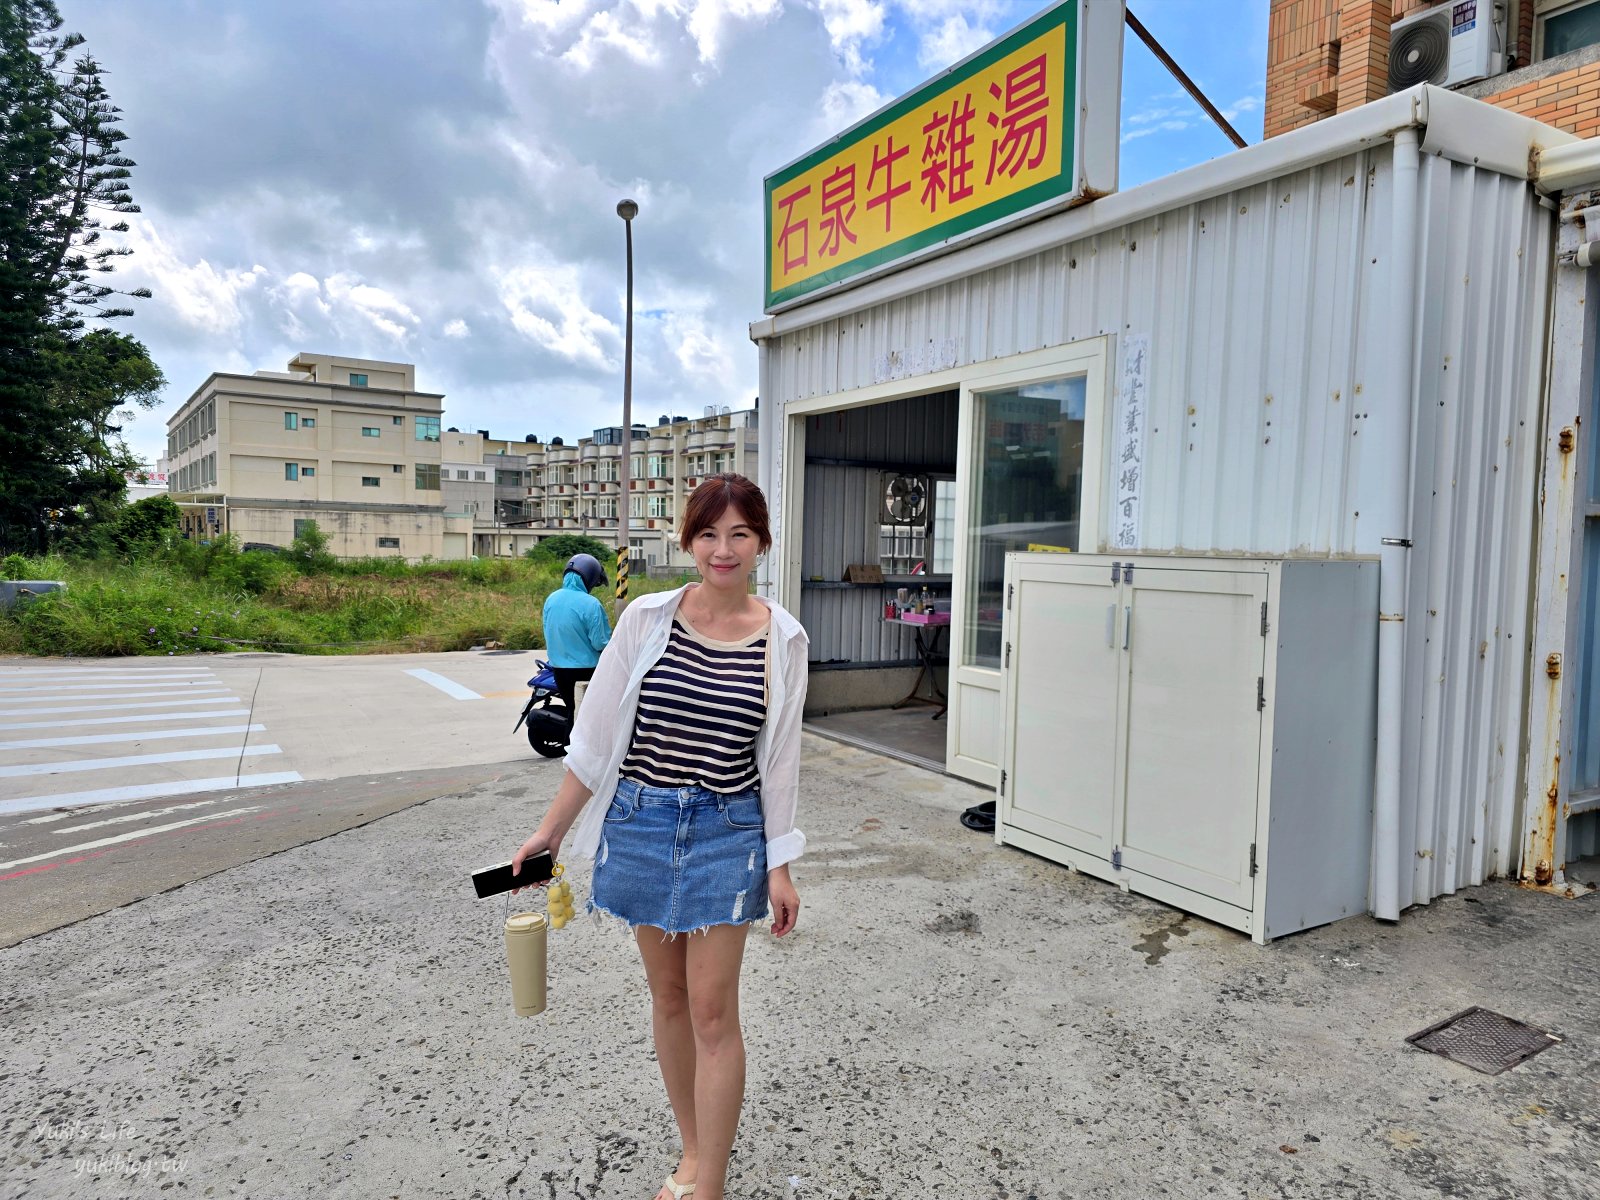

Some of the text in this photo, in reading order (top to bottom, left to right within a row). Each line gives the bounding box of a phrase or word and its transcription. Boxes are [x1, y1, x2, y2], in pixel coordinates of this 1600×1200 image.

[777, 53, 1050, 275] 石泉牛雜湯
